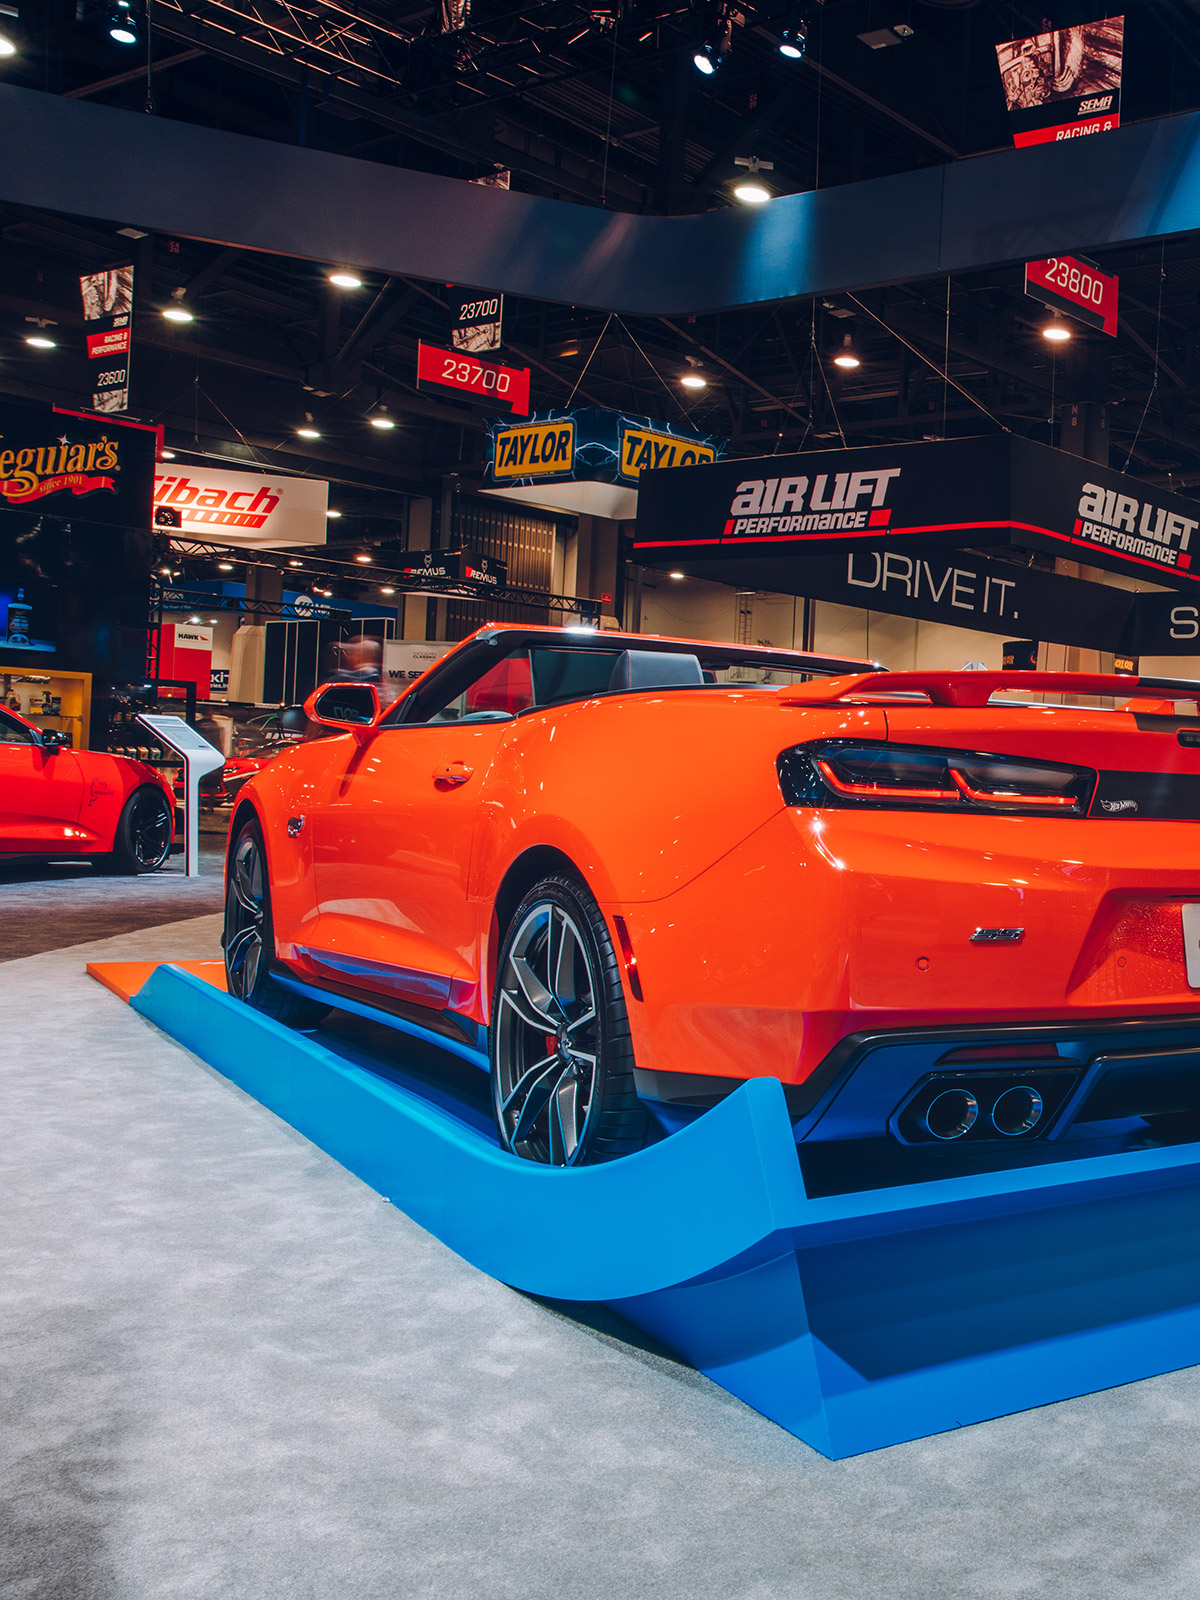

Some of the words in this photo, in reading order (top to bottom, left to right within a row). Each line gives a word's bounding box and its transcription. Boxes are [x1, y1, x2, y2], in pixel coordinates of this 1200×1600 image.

[1055, 122, 1101, 141] RACING
[1045, 257, 1103, 305] 23800
[458, 298, 498, 320] 23700
[97, 369, 126, 387] 23600
[441, 358, 511, 393] 23700
[498, 430, 570, 467] TAYLOR
[0, 435, 119, 498] eguiar's
[39, 478, 61, 493] since
[63, 475, 83, 486] 1901
[809, 467, 902, 511] LIFT
[733, 510, 868, 535] PERFORMANCE
[1138, 502, 1199, 551] LIFT
[1082, 520, 1178, 565] PERFORMANCE
[470, 569, 497, 585] REMUS
[847, 551, 977, 611] DRIVE
[983, 576, 1019, 620] IT.
[177, 633, 200, 641] HAWK
[389, 670, 406, 679] WE
